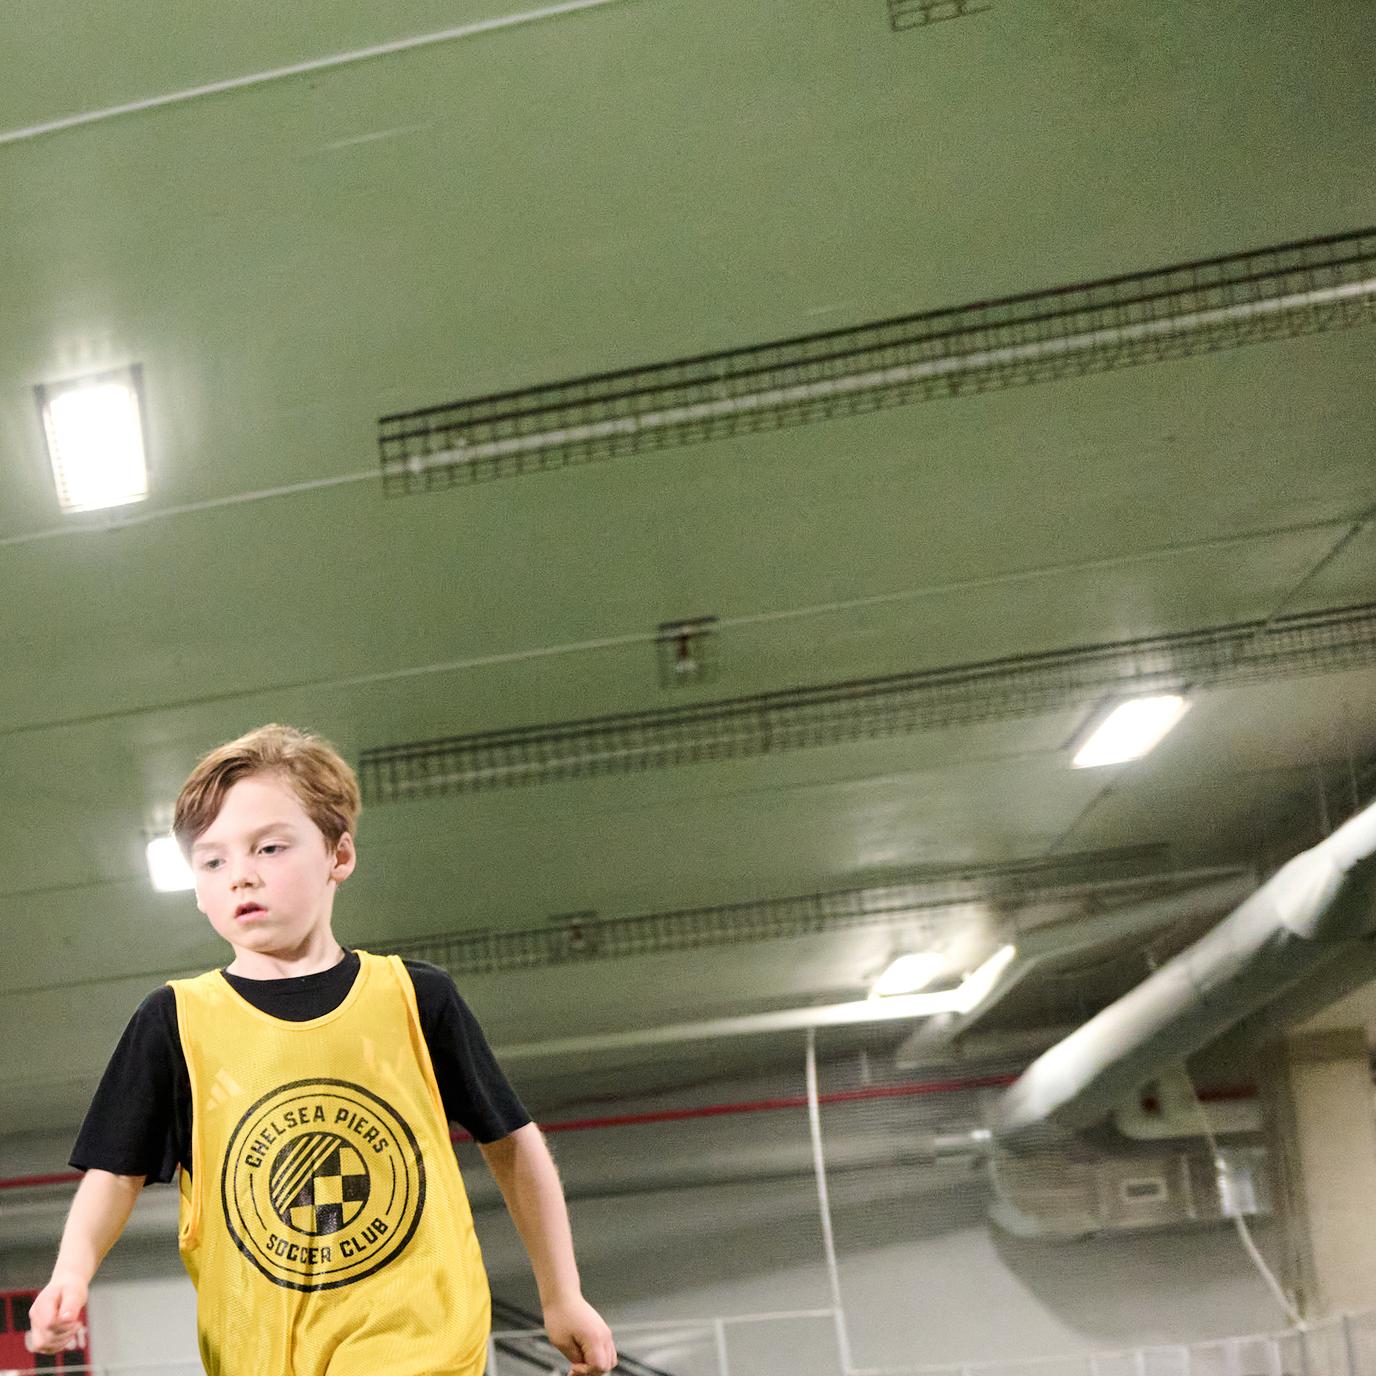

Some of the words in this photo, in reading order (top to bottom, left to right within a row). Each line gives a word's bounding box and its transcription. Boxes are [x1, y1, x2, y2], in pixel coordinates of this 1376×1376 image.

[245, 1105, 326, 1169] CHELSEA
[334, 1107, 389, 1154] PIERS
[266, 1232, 332, 1265] SOCCER
[339, 1217, 389, 1258] CLUB
